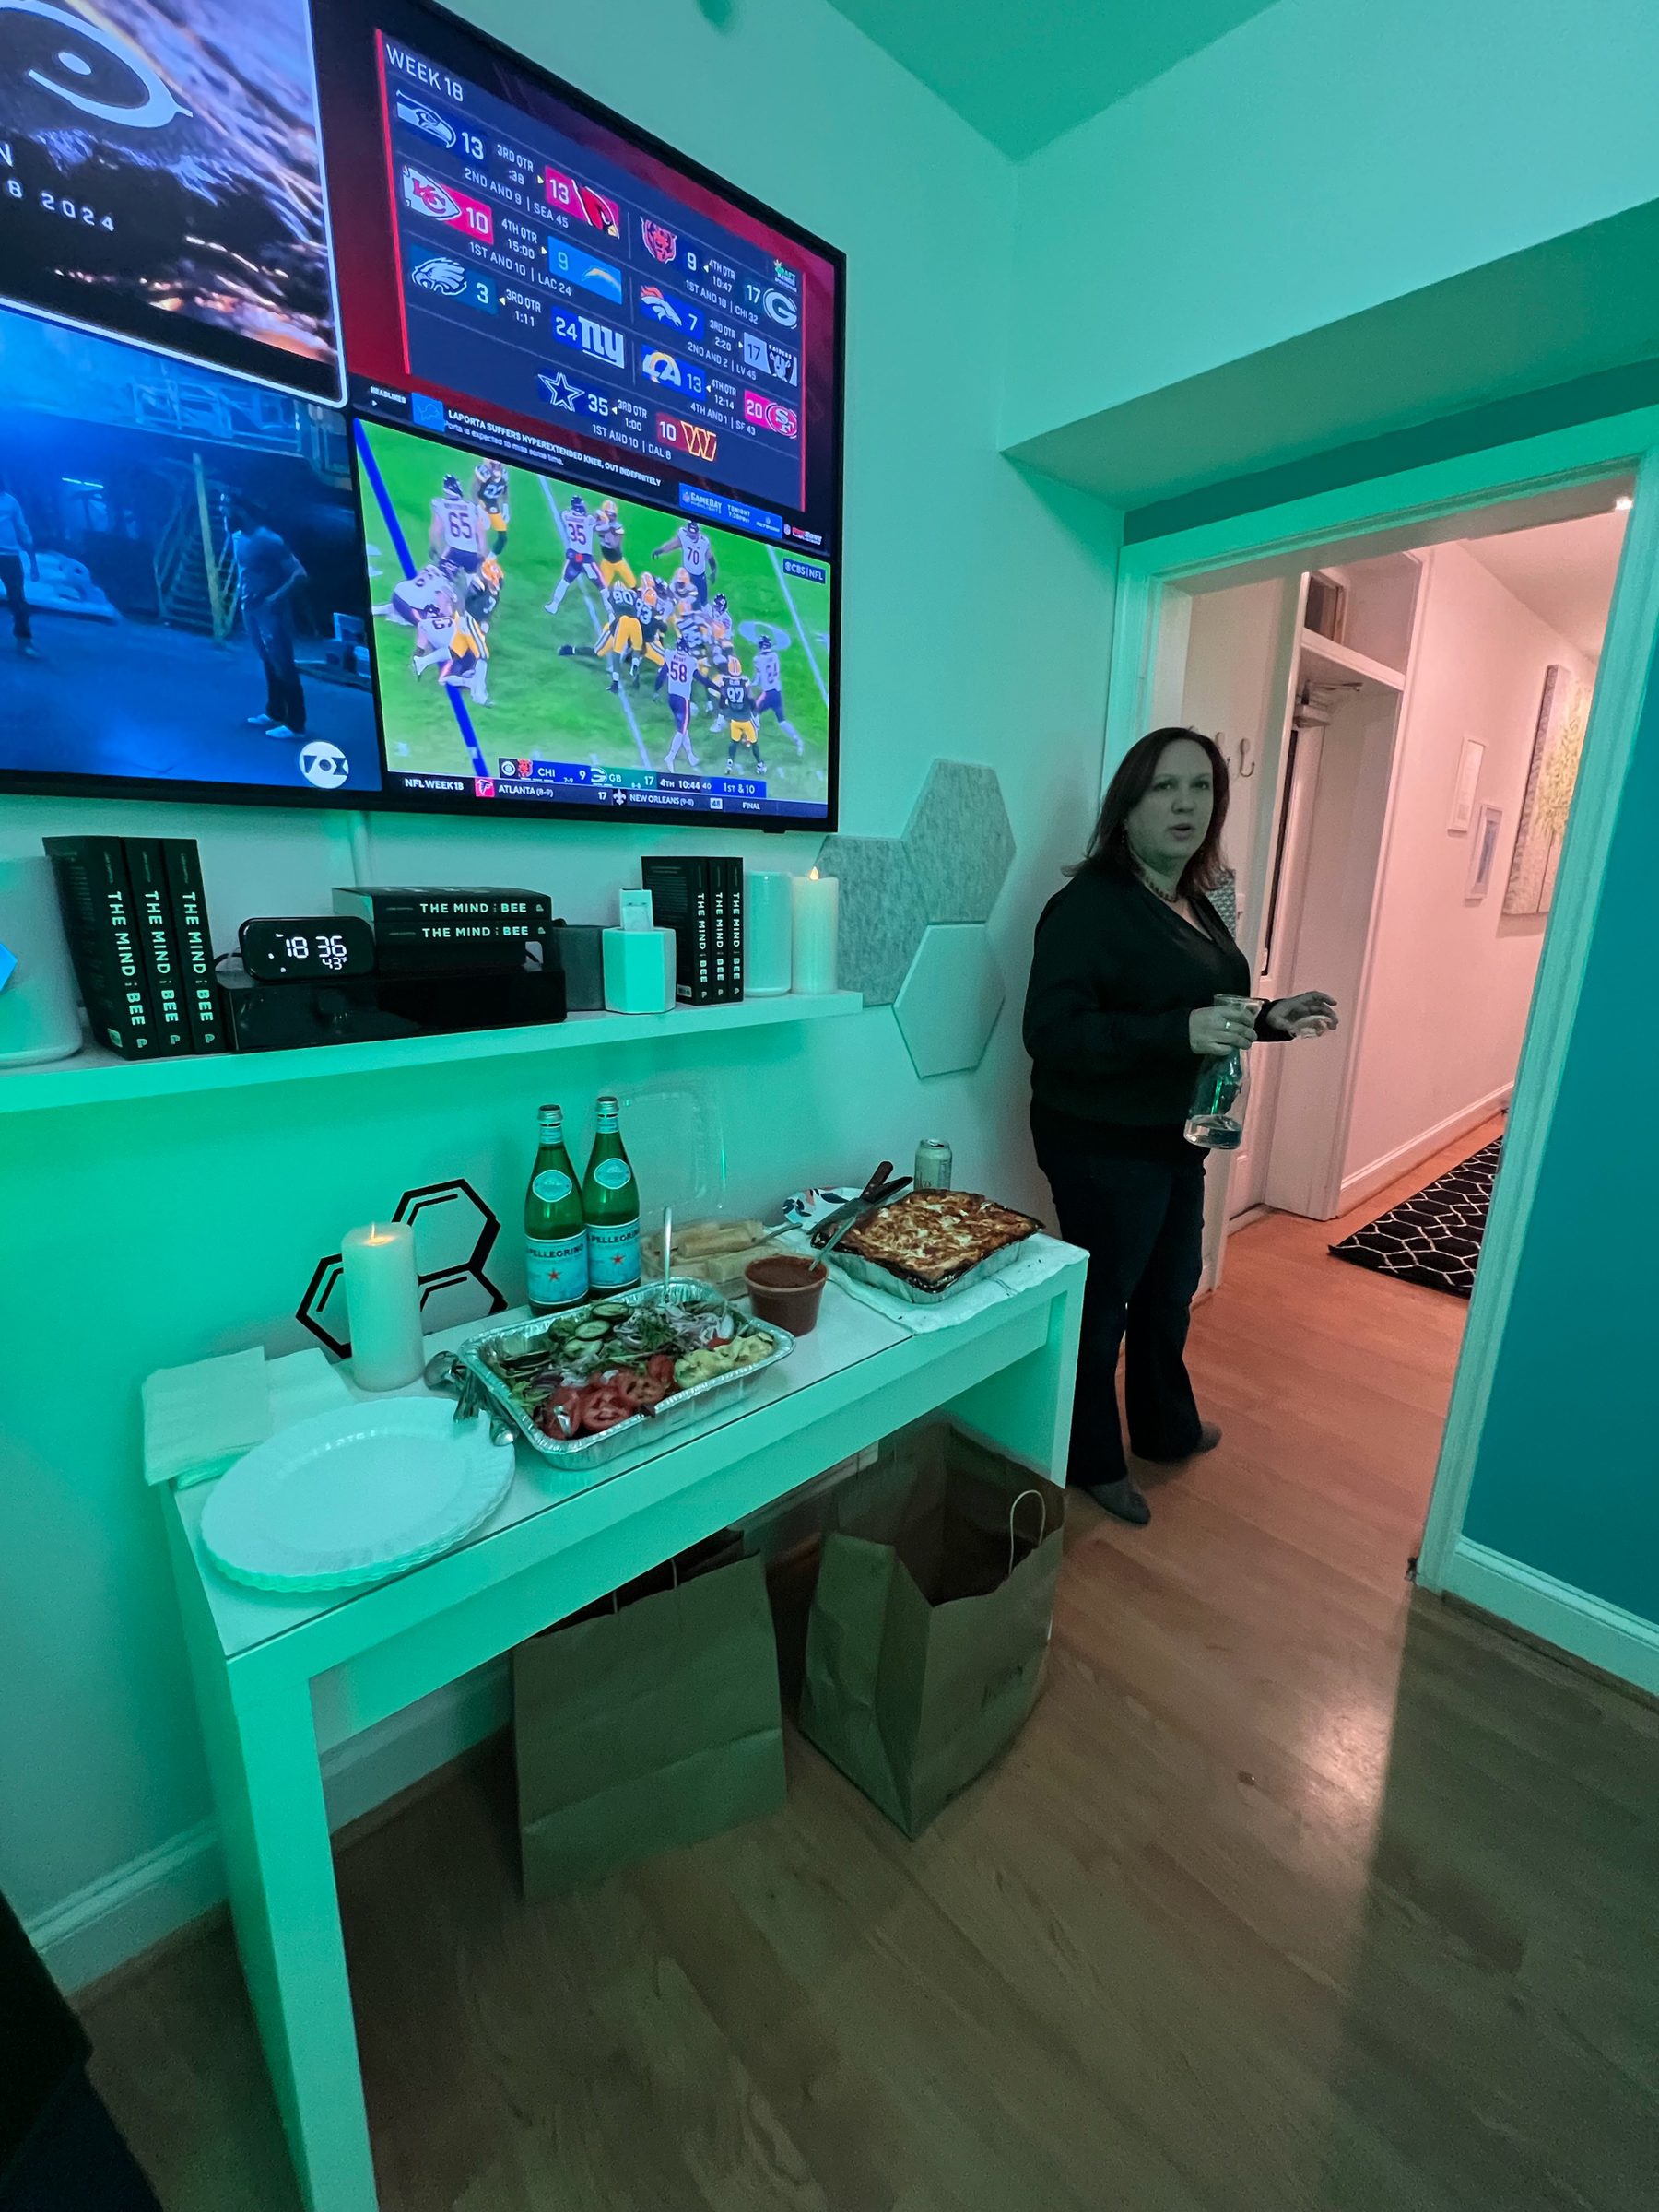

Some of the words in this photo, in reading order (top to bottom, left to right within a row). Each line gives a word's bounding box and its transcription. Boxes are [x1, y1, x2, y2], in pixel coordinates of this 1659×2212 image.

[386, 44, 441, 90] WEEK
[444, 77, 463, 102] 18
[462, 132, 484, 160] 13
[497, 144, 514, 162] 3RD
[516, 155, 534, 172] QTR
[465, 168, 488, 188] 2ND
[490, 181, 512, 200] AND
[514, 194, 523, 206] 9
[534, 202, 554, 222] SEA
[556, 214, 569, 229] 45
[549, 179, 570, 205] 13
[41, 192, 114, 231] 2024
[465, 206, 489, 235] 10
[501, 218, 519, 237] 4TH
[520, 226, 537, 244] QTR
[507, 238, 535, 260] 15:00
[469, 241, 488, 259] 1ST
[490, 250, 512, 270] AND
[514, 260, 526, 276] 10
[537, 272, 558, 291] LAC
[559, 281, 572, 297] 24
[557, 251, 569, 272] 9
[687, 252, 697, 272] 9
[709, 259, 722, 273] 4TH
[723, 265, 735, 280] QTR
[477, 282, 489, 305] 3
[712, 276, 733, 293] 10:47
[747, 284, 761, 305] 17
[506, 289, 524, 308] 3RD
[524, 296, 542, 314] QTR
[686, 279, 700, 293] 1ST
[700, 287, 717, 304] AND
[718, 295, 727, 309] 10
[735, 305, 747, 320] CHI
[748, 313, 759, 324] 32
[514, 310, 535, 328] 1:11
[555, 316, 578, 342] 24
[688, 313, 698, 332] 7
[709, 319, 723, 334] 3RD
[724, 325, 736, 340] QTR
[714, 336, 732, 352] 2:20
[747, 343, 761, 361] 17
[768, 344, 792, 360] RAIDERS
[688, 341, 705, 357] 2ND
[706, 348, 723, 365] AND
[723, 355, 729, 368] 2
[736, 362, 747, 377] LV
[747, 369, 757, 381] 45
[687, 372, 702, 394] 13
[711, 378, 724, 392] 4TH
[724, 383, 737, 398] QTR
[587, 394, 609, 416] 35
[618, 399, 630, 414] 3RD
[630, 404, 648, 419] QTR
[714, 394, 735, 410] 12:14
[747, 399, 763, 419] 20
[625, 418, 642, 432] 1:00
[690, 401, 705, 416] 4TH
[707, 407, 723, 423] AND
[724, 413, 728, 425] 1
[735, 419, 747, 432] SF
[747, 424, 756, 436] 43
[593, 424, 607, 438] 1ST
[609, 429, 628, 445] AND
[629, 436, 639, 449] 10
[648, 443, 665, 458] DAL
[665, 450, 672, 460] 8
[660, 421, 677, 441] 10
[680, 421, 716, 462] W
[448, 409, 486, 429] LAPORTA
[487, 422, 521, 441] SUFFERS
[522, 434, 583, 461] HYPEREXTENDED
[604, 462, 618, 473] OUT
[619, 465, 662, 487] INDEFINITELY
[471, 430, 503, 446] expected
[503, 440, 512, 449] to
[528, 449, 547, 460] some
[449, 512, 473, 539] 65
[567, 523, 587, 546] 35
[686, 546, 700, 566] 70
[791, 563, 806, 576] CBS
[809, 568, 824, 581] NFL
[613, 591, 634, 606] 90
[670, 661, 688, 683] 58
[405, 778, 425, 789] NFL
[425, 779, 453, 791] WEEK
[454, 782, 465, 791] 18
[537, 767, 556, 778] CHI
[579, 770, 587, 781] 9
[609, 773, 622, 783] GB
[644, 775, 654, 786] 17
[660, 778, 675, 788] 4TH
[678, 780, 700, 791] 10:44
[724, 782, 735, 793] 1ST
[737, 783, 745, 794] &
[746, 784, 756, 794] 10
[498, 784, 535, 795] ATLANTA
[598, 792, 607, 801] 17
[629, 794, 648, 803] NEW
[648, 795, 680, 805] ORLEANS
[742, 801, 760, 810] FINAL
[108, 890, 127, 926] THE
[144, 890, 163, 924] THE
[182, 891, 200, 925] THE
[419, 903, 450, 913] THE
[453, 902, 488, 913] MIND
[500, 902, 527, 912] BEE
[697, 893, 705, 916] THE
[715, 892, 724, 915] THE
[421, 927, 451, 938] THE
[455, 926, 491, 937] MIND
[502, 925, 529, 936] BEE
[698, 920, 706, 950] MIND
[114, 932, 136, 977] MIND
[151, 931, 171, 974] MIND
[187, 931, 206, 974] MIND
[286, 936, 309, 959] 18
[315, 935, 347, 958] 36
[700, 959, 708, 982] BEE
[716, 959, 724, 981] BEE
[126, 992, 147, 1026] BEE
[160, 989, 179, 1023] BEE
[196, 989, 214, 1022] BEE
